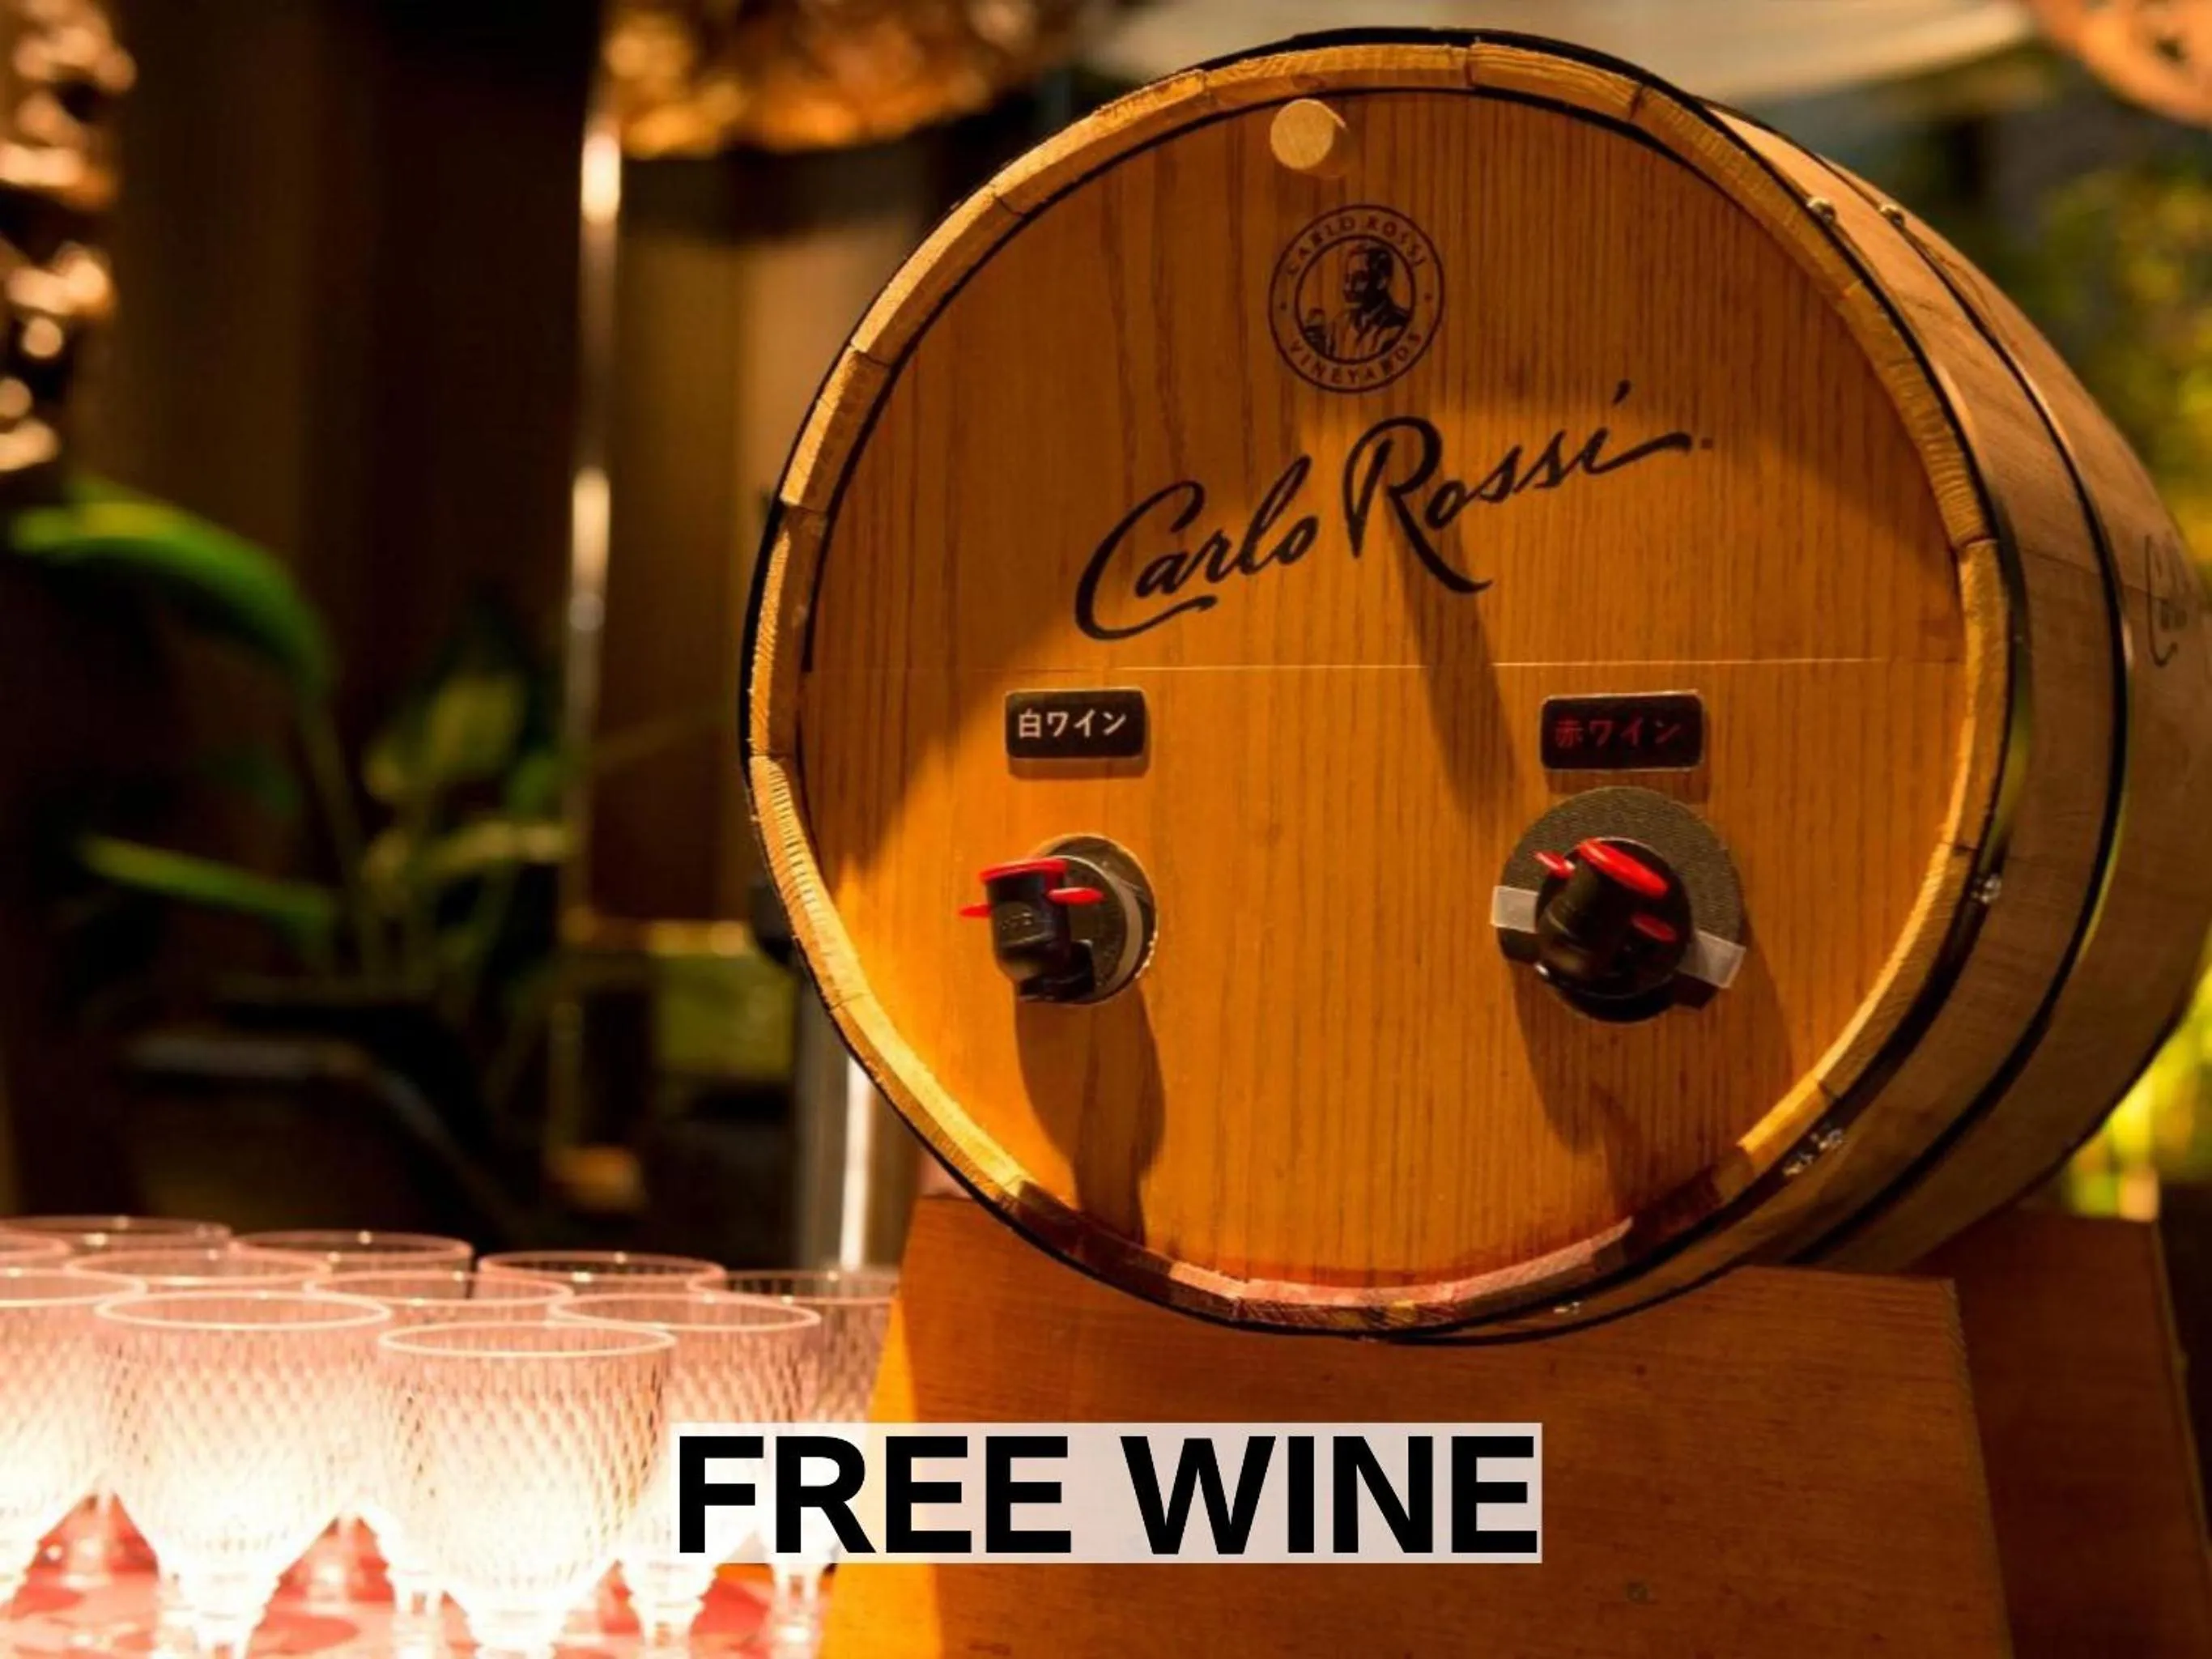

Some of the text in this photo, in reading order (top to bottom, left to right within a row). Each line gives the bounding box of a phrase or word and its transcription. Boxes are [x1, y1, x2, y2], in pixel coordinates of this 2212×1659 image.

[1074, 380, 1694, 641] Carlo Rossi
[1018, 708, 1128, 740] 白ワイン
[1554, 714, 1682, 749] 赤ワイン
